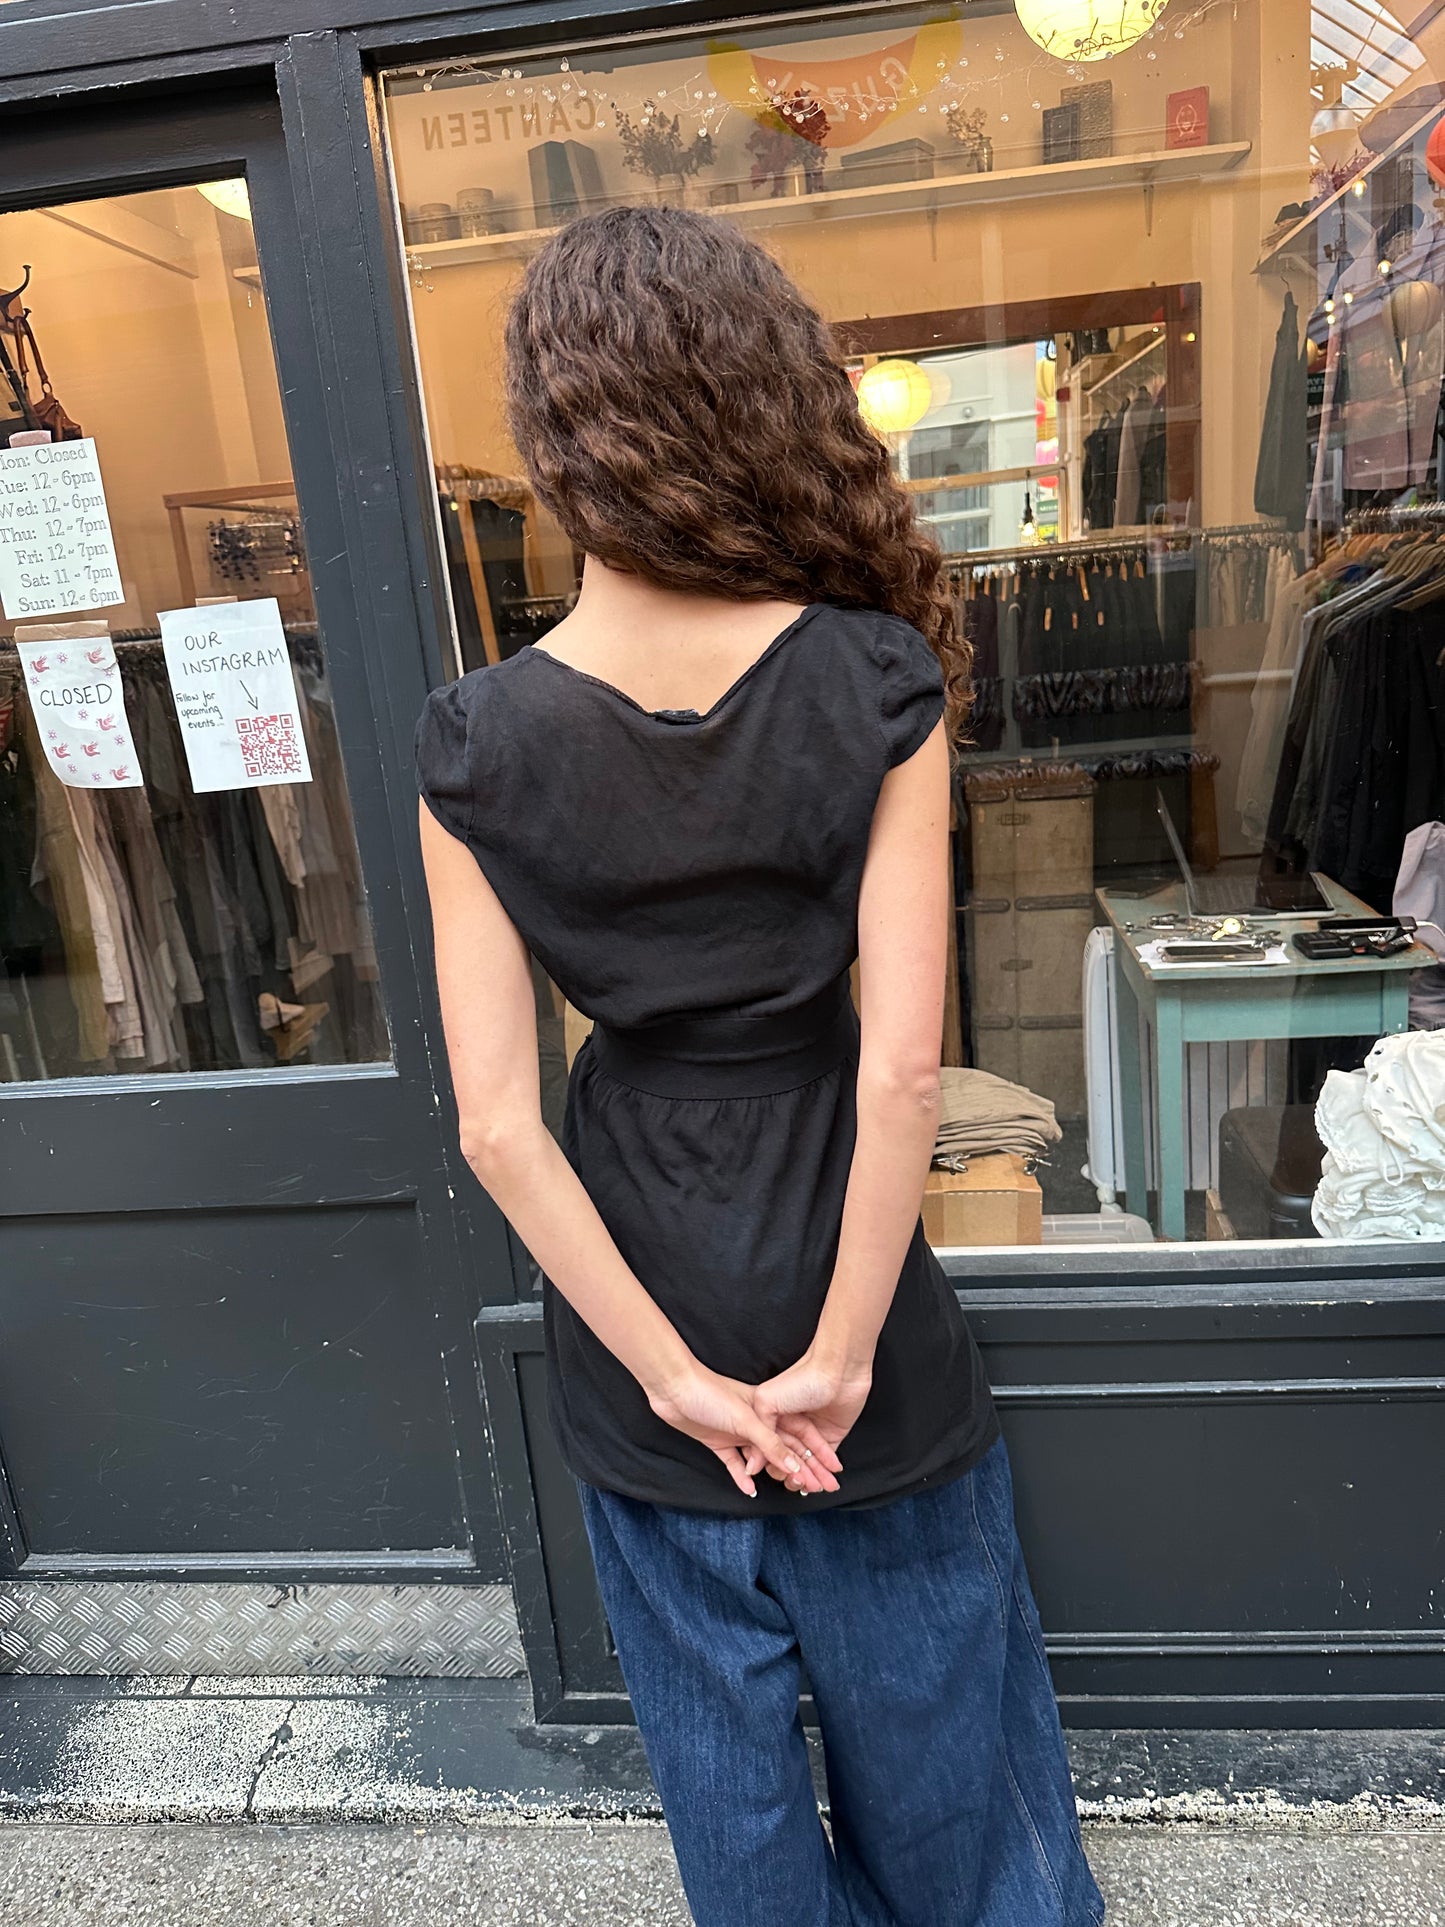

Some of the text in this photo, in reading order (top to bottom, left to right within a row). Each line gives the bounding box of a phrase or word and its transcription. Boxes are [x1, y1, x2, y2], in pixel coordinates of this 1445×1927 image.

[34, 442, 88, 464] Closed
[0, 500, 39, 519] Wed:
[0, 527, 37, 543] Thu:
[14, 550, 44, 565] Fri:
[20, 573, 51, 588] Sat:
[18, 597, 56, 612] Sun:
[184, 631, 222, 651] OUR
[182, 648, 285, 676] INSTAGRAM
[39, 683, 113, 707] CLOSED
[175, 690, 216, 707] Follow for
[180, 705, 223, 720] upcoming
